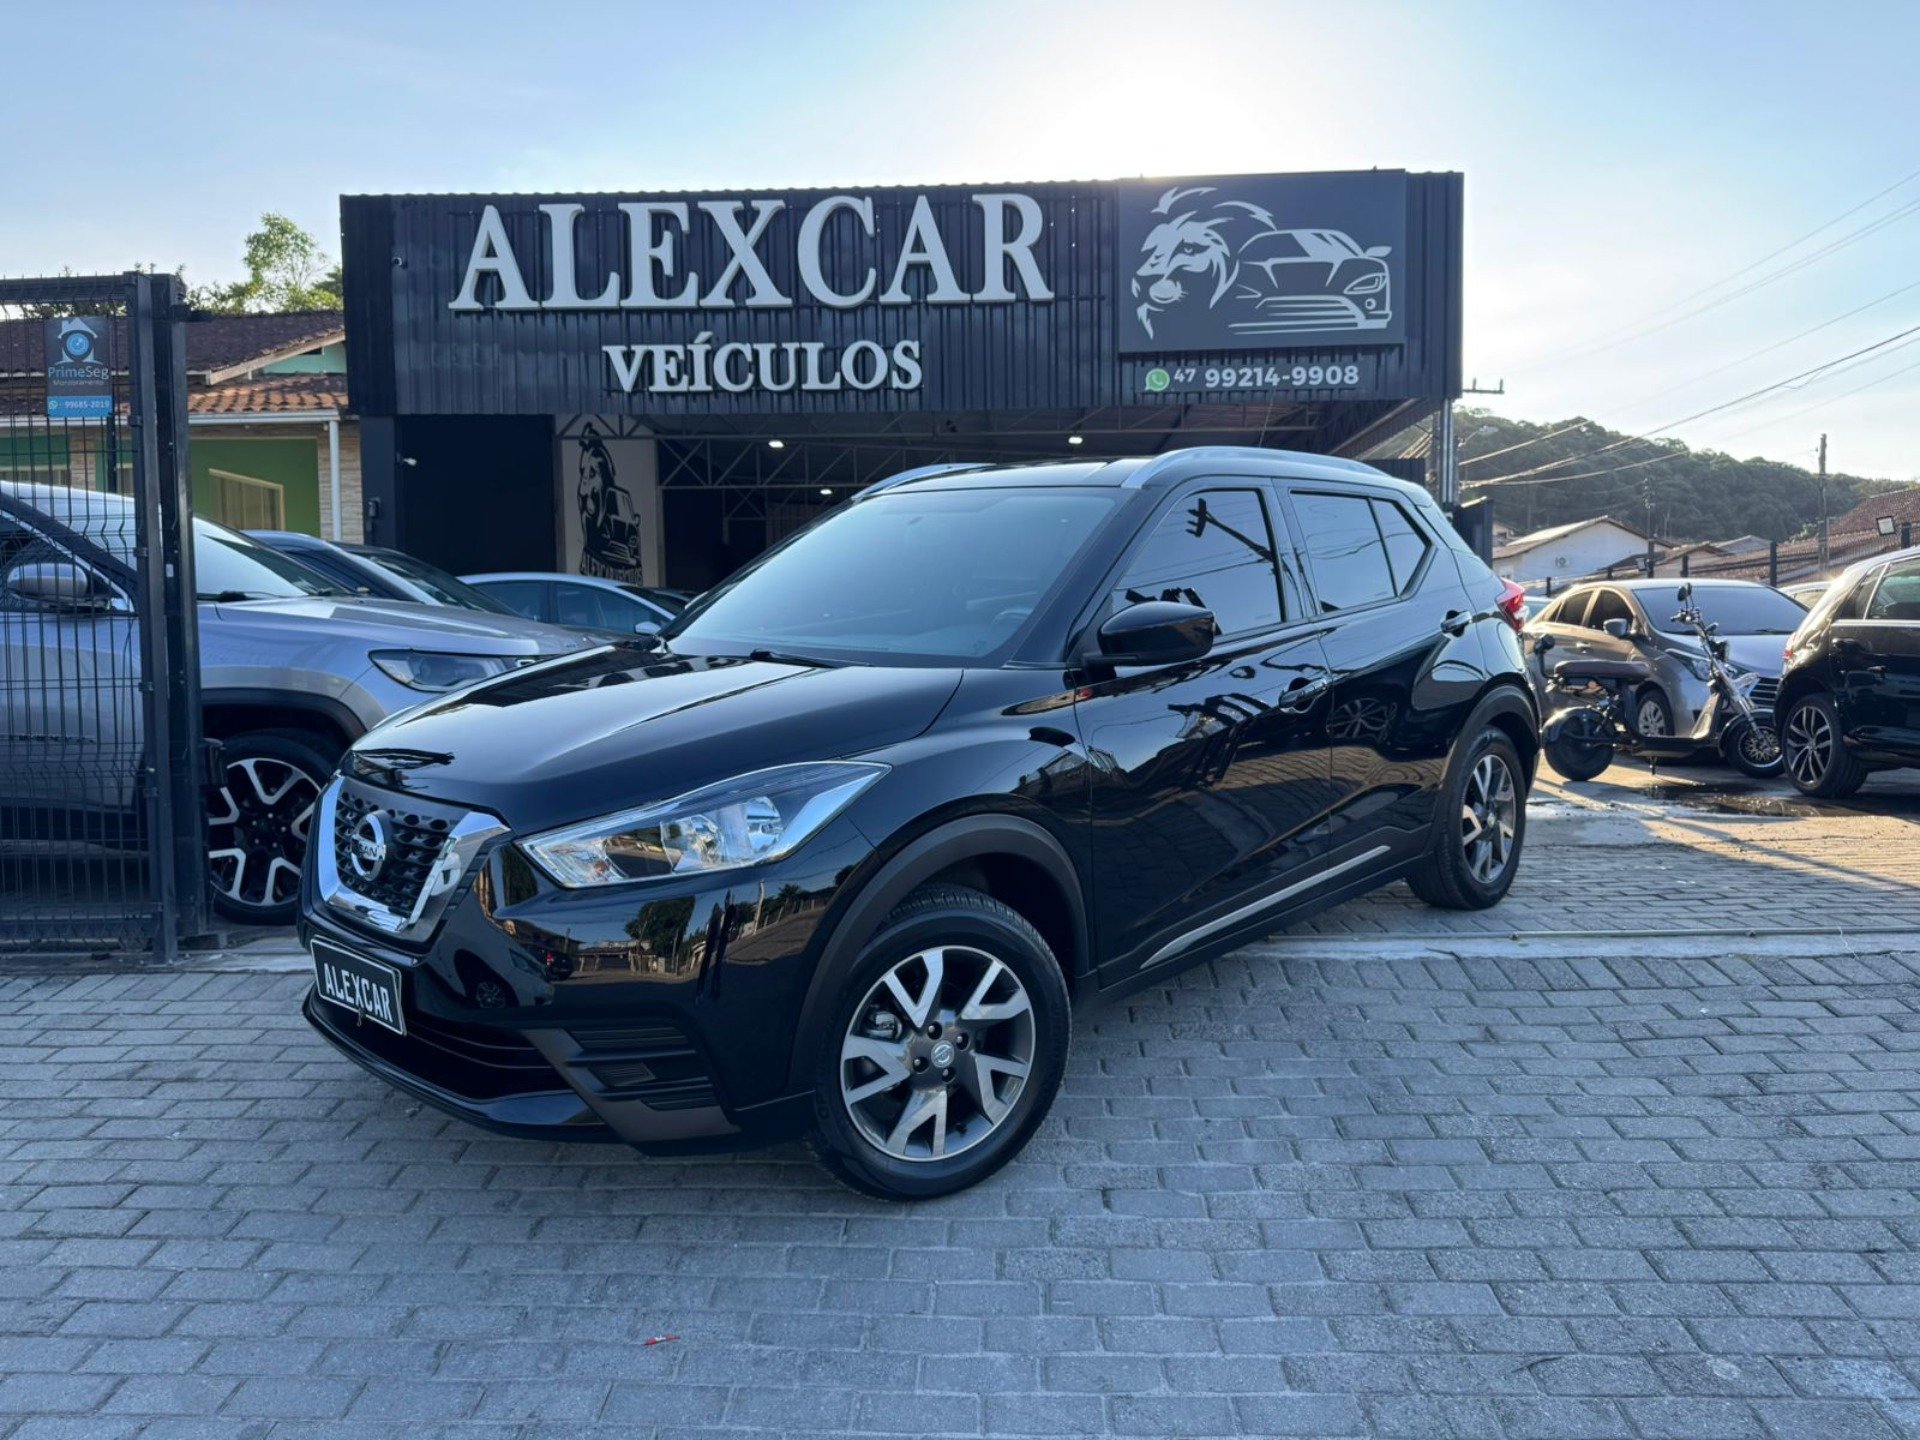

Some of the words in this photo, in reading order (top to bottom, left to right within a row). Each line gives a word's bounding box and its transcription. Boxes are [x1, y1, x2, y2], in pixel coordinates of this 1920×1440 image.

[448, 194, 1055, 310] ALEXCAR
[48, 366, 110, 380] PrimeSeg
[602, 331, 923, 393] VEÍCULOS
[1174, 368, 1197, 383] 47
[1204, 365, 1360, 388] 99214-9908
[323, 962, 394, 1023] ALEXCAR
